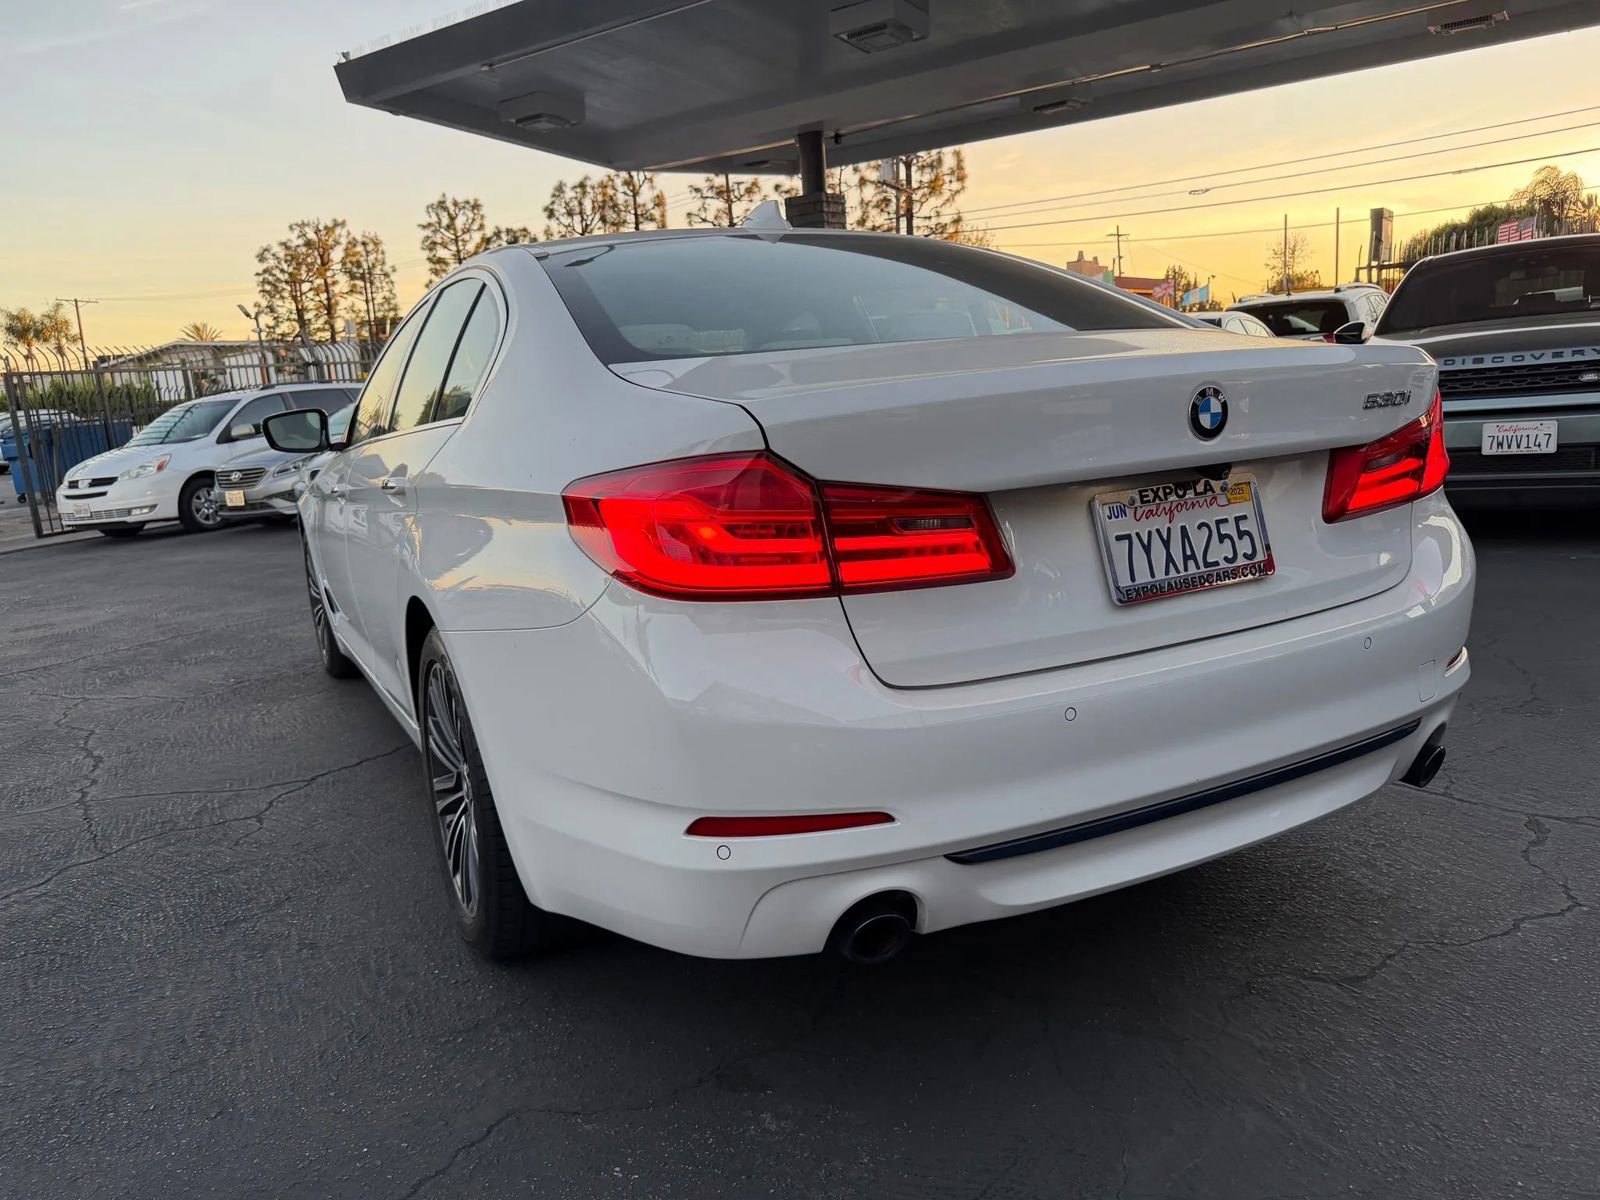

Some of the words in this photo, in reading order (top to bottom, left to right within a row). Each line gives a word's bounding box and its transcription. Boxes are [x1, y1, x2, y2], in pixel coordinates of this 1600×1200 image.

[1194, 387, 1225, 405] BMW
[1363, 390, 1411, 409] 530i
[1487, 433, 1552, 450] 7WVV147
[1230, 486, 1245, 495] 2025
[1106, 504, 1128, 520] JUN
[1133, 495, 1230, 523] California
[1114, 514, 1258, 583] 7YXA255
[1124, 561, 1268, 601] EXPOLAUSEDCARS.COM
